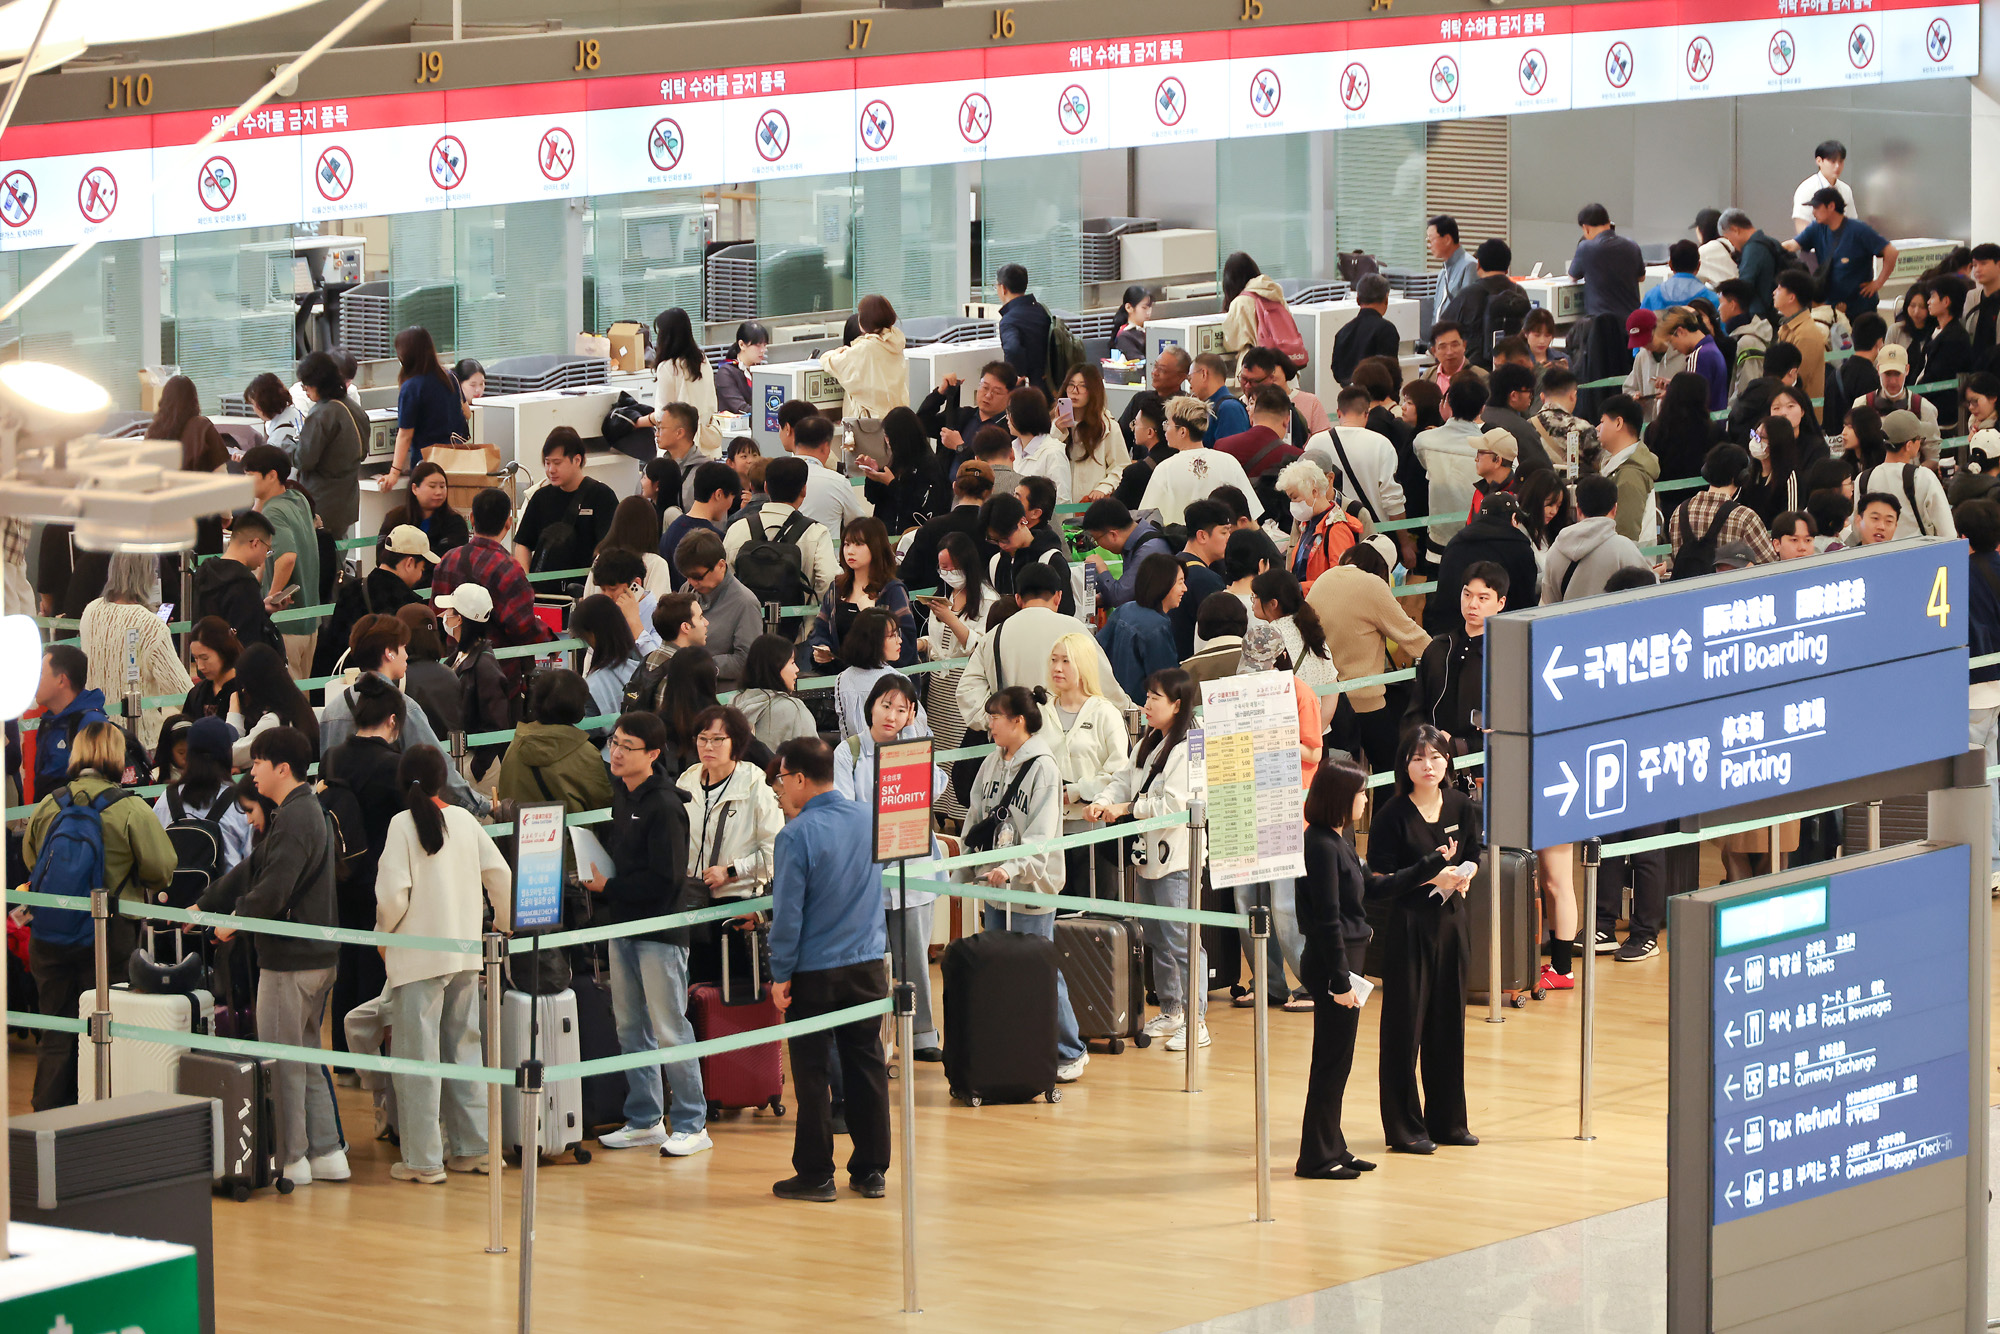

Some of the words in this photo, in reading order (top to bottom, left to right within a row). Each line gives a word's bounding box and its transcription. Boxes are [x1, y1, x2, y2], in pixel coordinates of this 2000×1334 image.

[848, 19, 872, 49] J7
[992, 9, 1015, 38] J6
[1440, 19, 1462, 39] 위탁
[1464, 16, 1498, 37] 수하물
[1499, 14, 1521, 35] 금지
[1523, 13, 1545, 33] 품목
[417, 52, 443, 83] J9
[575, 40, 601, 71] J8
[1069, 46, 1093, 67] 위탁
[1095, 43, 1131, 65] 수하물
[1134, 41, 1157, 62] 금지
[1160, 39, 1183, 60] 품목
[109, 74, 152, 108] J10
[660, 77, 687, 100] 위탁
[689, 74, 729, 98] 수하물
[731, 71, 757, 94] 금지
[760, 70, 786, 93] 품목
[242, 111, 285, 135] 수하물
[288, 107, 316, 131] 금지
[320, 105, 349, 128] 품목
[1926, 566, 1951, 628] 4
[1584, 628, 1693, 689] 국제선탑승
[1703, 642, 1740, 680] Int'l
[1744, 630, 1828, 673] Boarding
[1638, 736, 1711, 793] 주차장
[1720, 749, 1792, 790] Parking
[881, 784, 901, 796] SKY
[881, 791, 926, 806] PRIORITY
[1769, 951, 1801, 979] 화장실
[1806, 958, 1835, 977] Toilets
[1796, 1003, 1817, 1028] 음료
[1821, 1007, 1846, 1028] Food,
[1849, 1000, 1892, 1021] Beverages
[1795, 1066, 1833, 1087] Currency
[1835, 1055, 1876, 1076] Exchange
[1769, 1119, 1792, 1142] Tax
[1796, 1100, 1841, 1135] Refund
[1846, 1154, 1883, 1179] Oversized
[1885, 1148, 1917, 1169] Baggage
[1918, 1137, 1952, 1158] Check-in
[1769, 1172, 1779, 1195] 큰
[1783, 1168, 1793, 1191] 짐
[1797, 1161, 1826, 1187] 부치는
[1830, 1155, 1840, 1178] 곳
